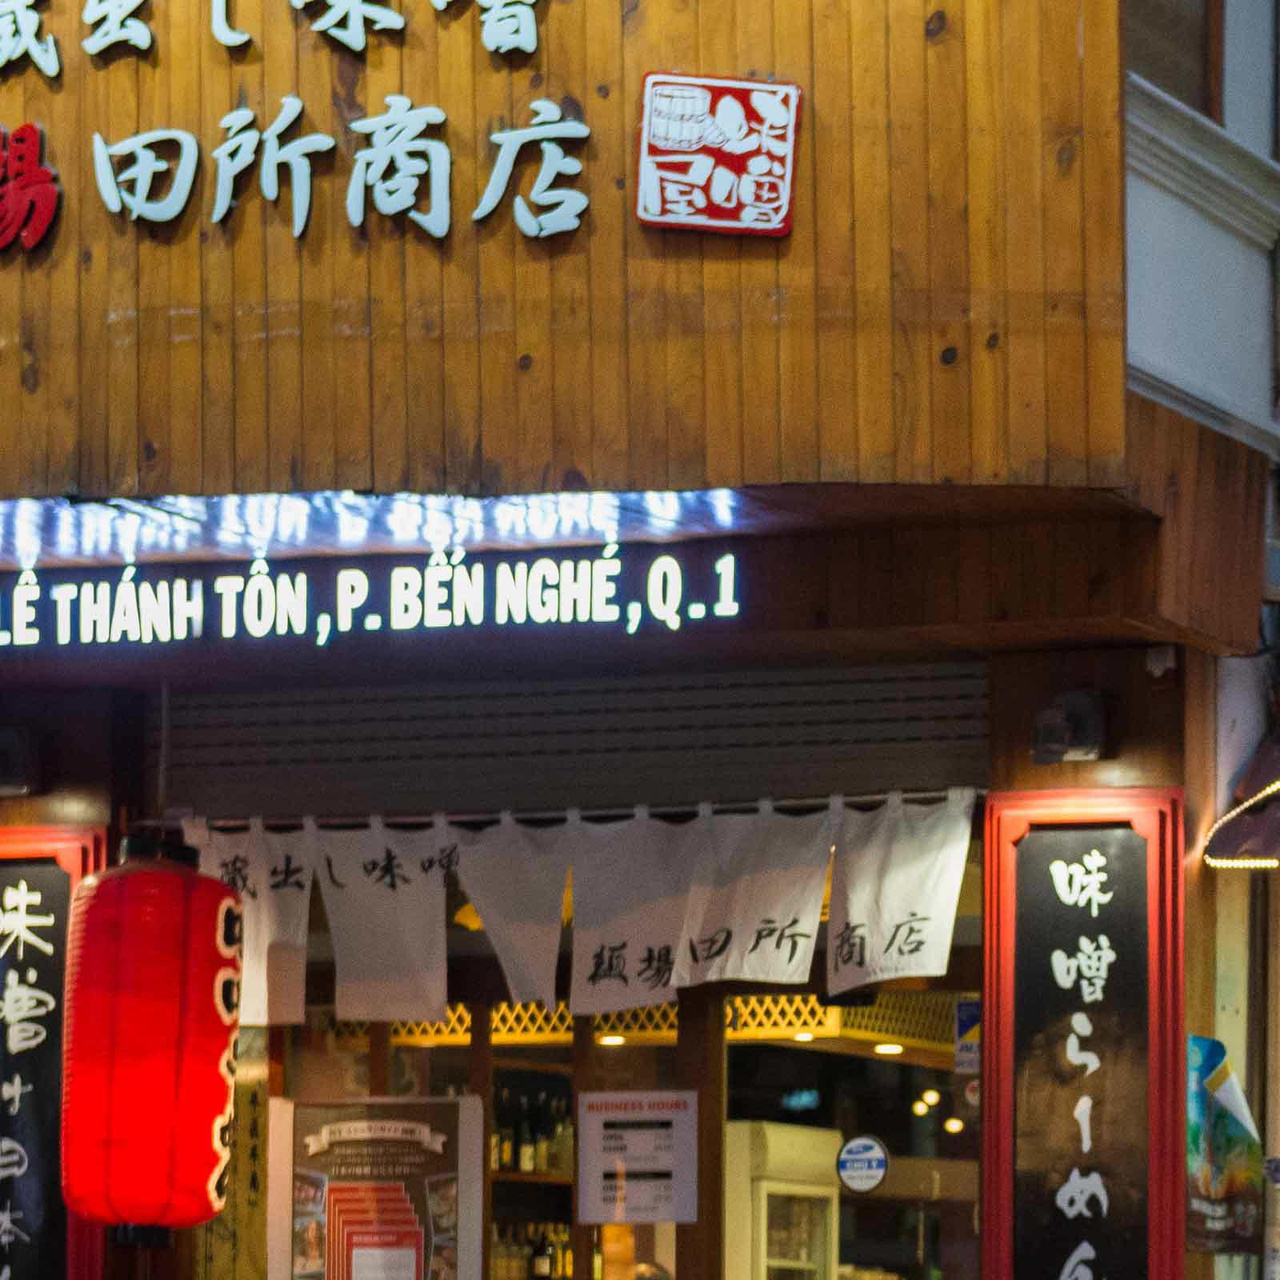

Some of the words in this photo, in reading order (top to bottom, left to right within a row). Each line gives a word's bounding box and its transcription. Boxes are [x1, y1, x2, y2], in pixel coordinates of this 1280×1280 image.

[92, 94, 590, 238] 田所商店
[51, 564, 203, 645] THÁNH
[390, 546, 484, 630] BẾN
